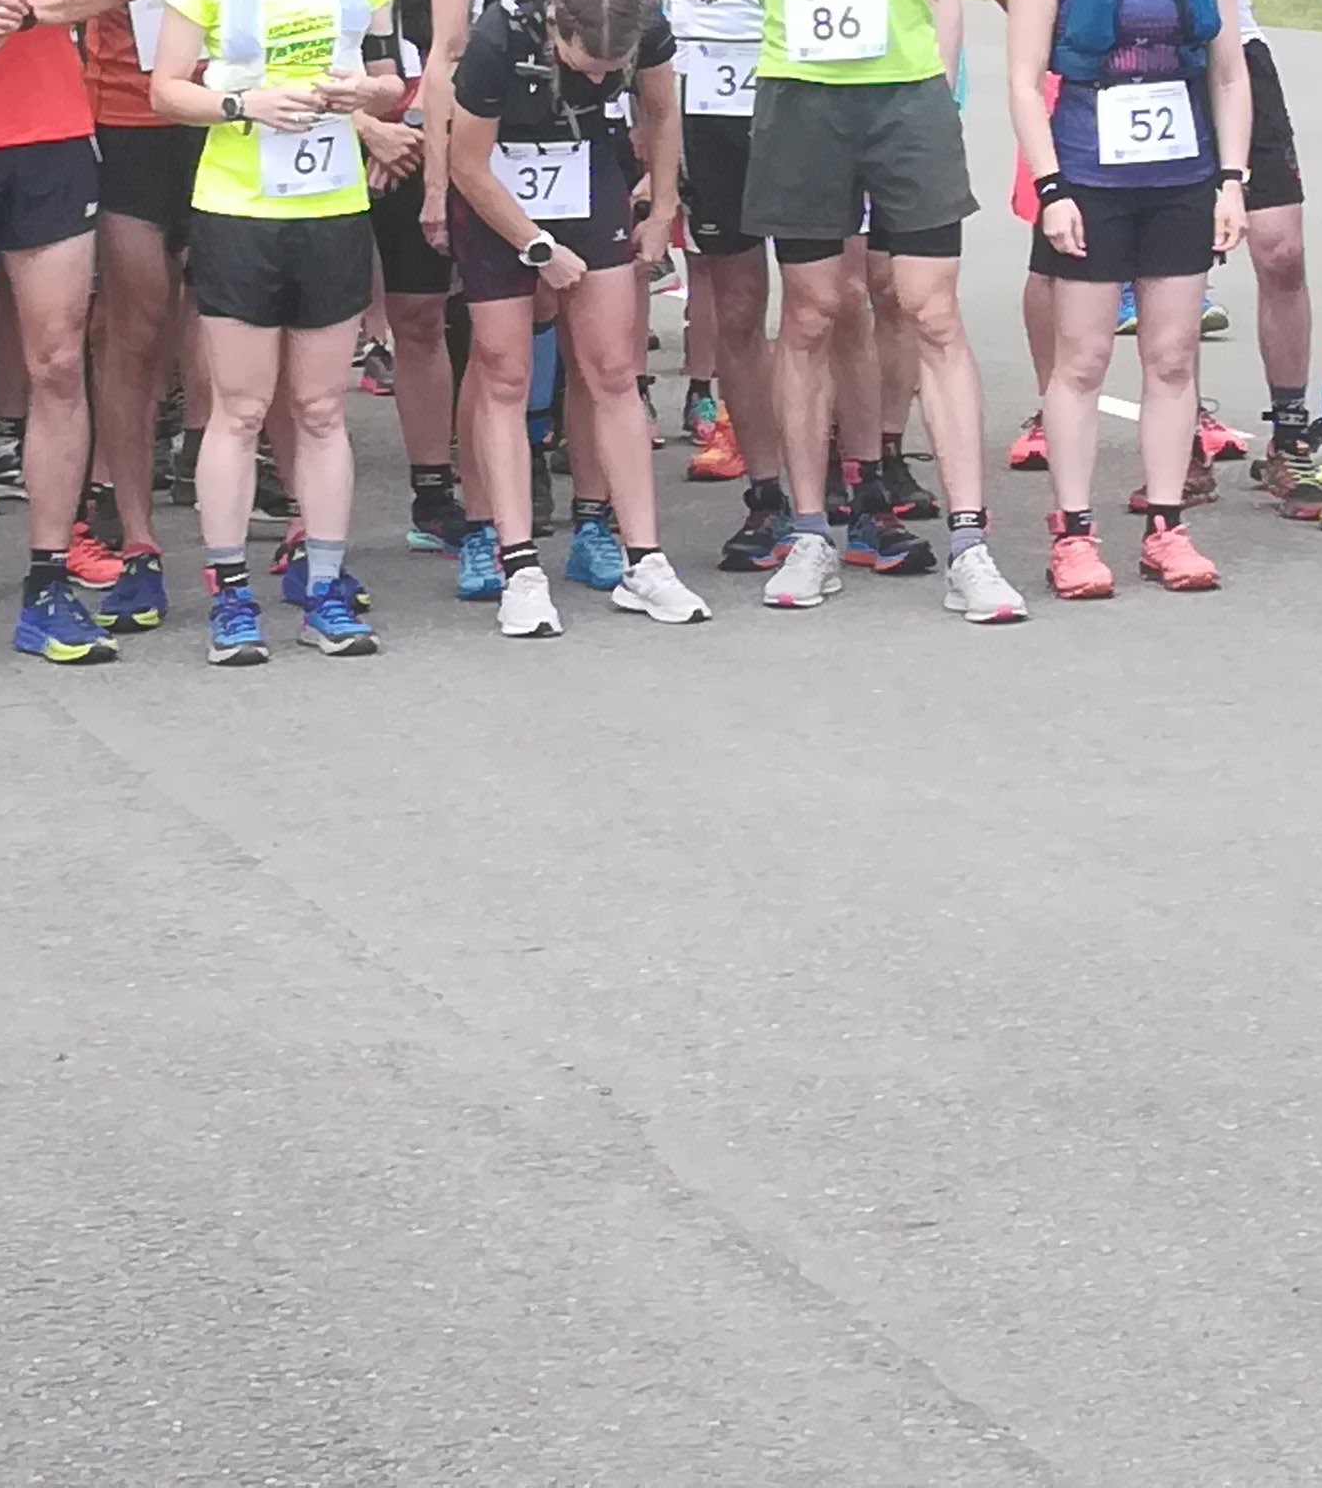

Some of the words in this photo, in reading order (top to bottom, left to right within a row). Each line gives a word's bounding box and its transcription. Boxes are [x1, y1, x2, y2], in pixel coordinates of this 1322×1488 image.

[813, 6, 861, 41] 86
[1129, 106, 1175, 142] 52
[293, 136, 335, 175] 67
[517, 165, 562, 200] 37
